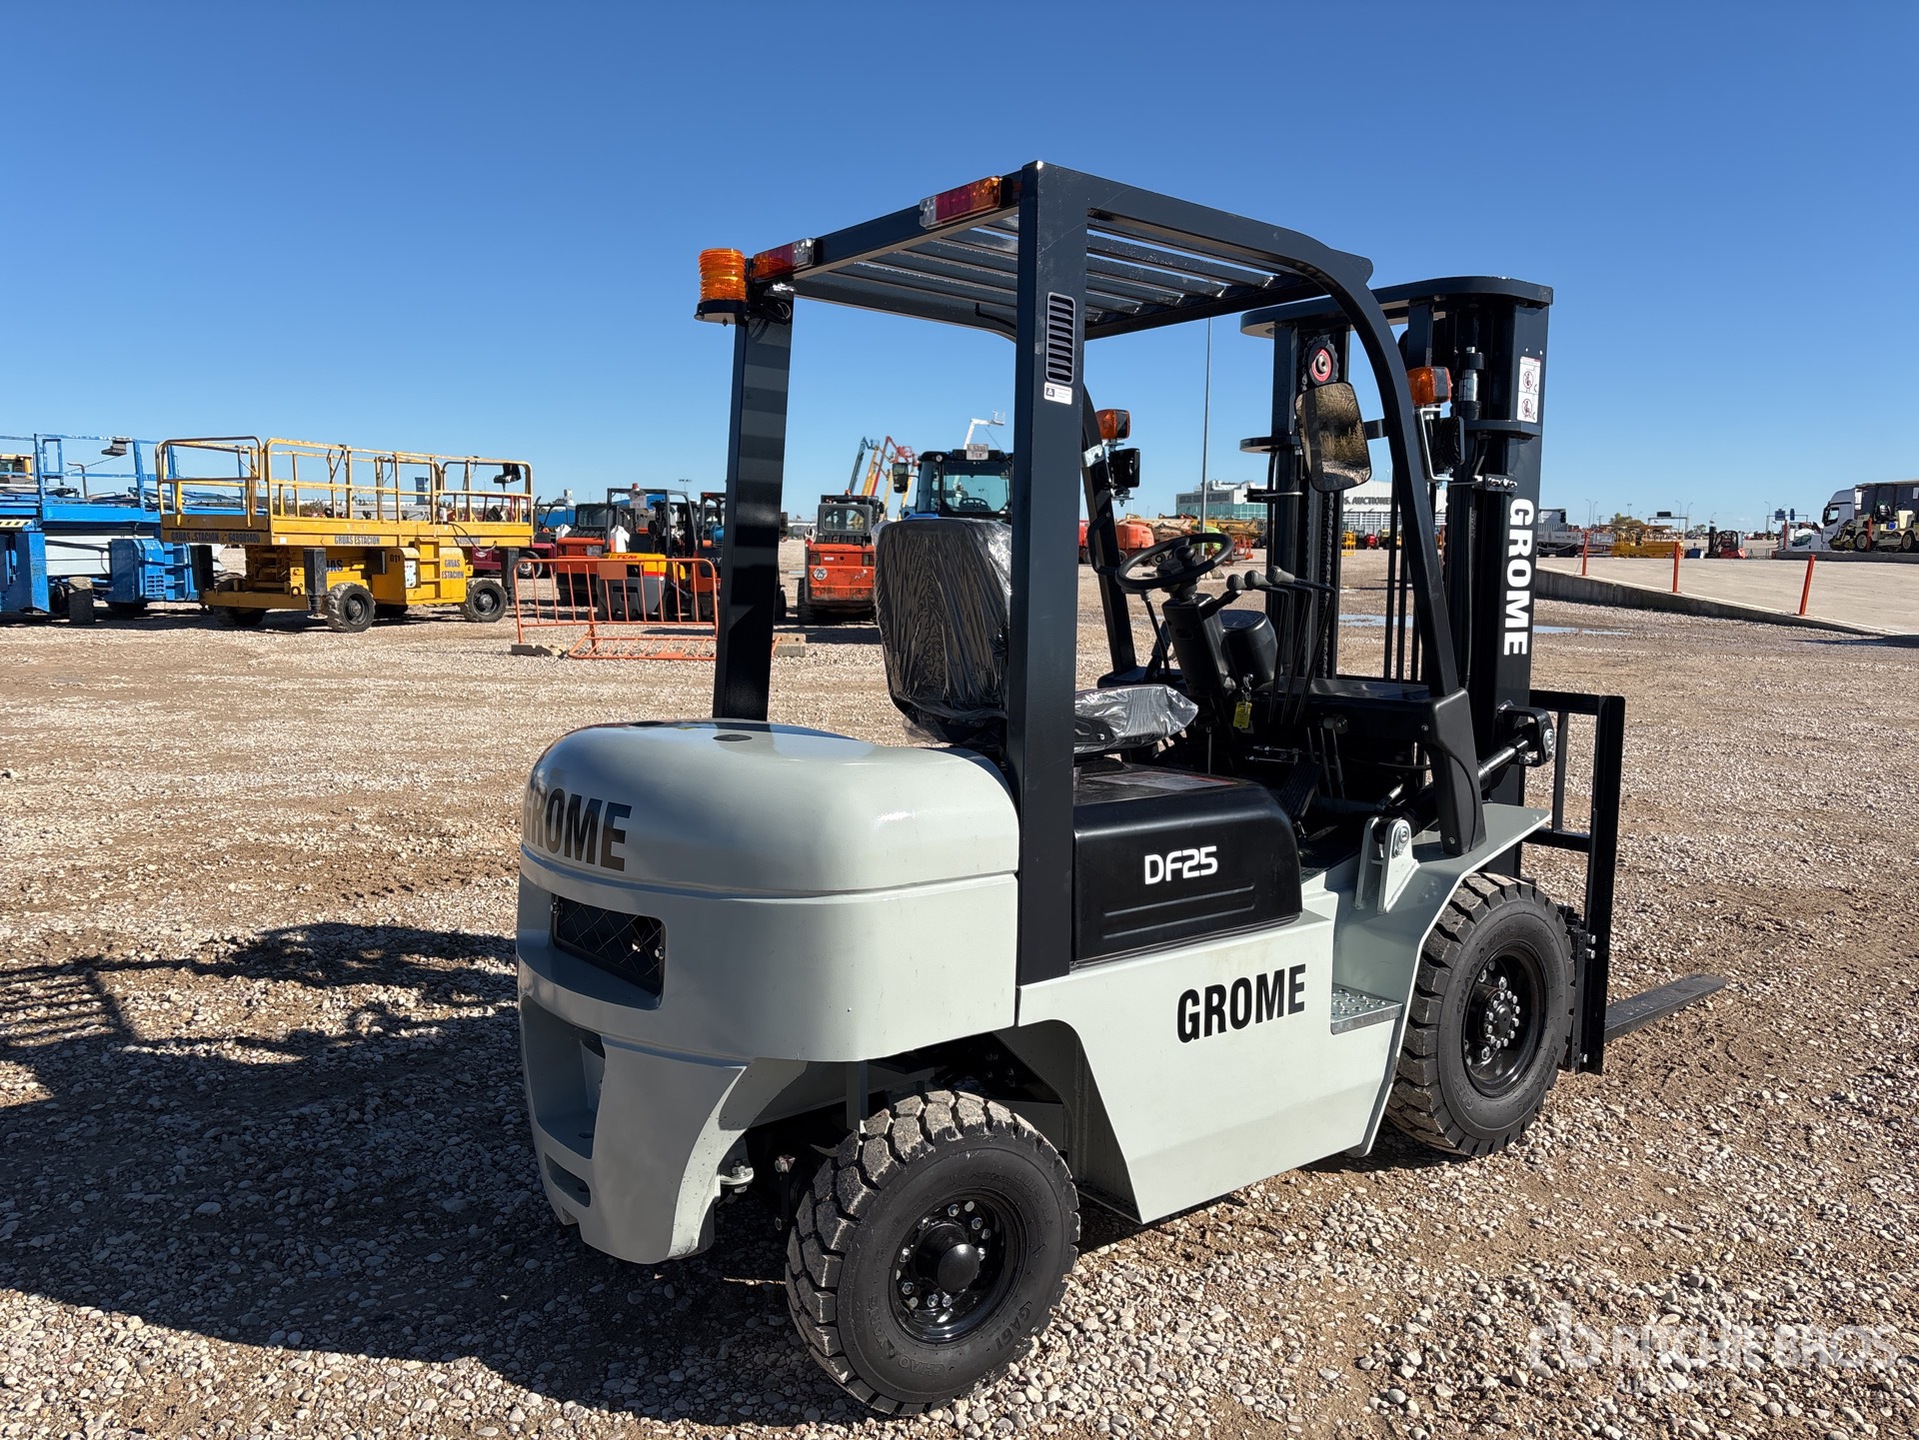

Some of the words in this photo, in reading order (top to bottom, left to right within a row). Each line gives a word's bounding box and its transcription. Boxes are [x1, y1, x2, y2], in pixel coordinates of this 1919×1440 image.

[192, 532, 219, 542] STACION
[334, 535, 353, 545] GRUAS
[355, 535, 380, 545] ESTACION
[442, 571, 464, 579] ESTACION
[445, 560, 460, 568] GRUAS
[1503, 498, 1535, 656] GROME
[523, 783, 633, 872] GROME
[1144, 845, 1219, 885] DF25
[1177, 963, 1307, 1043] GROME
